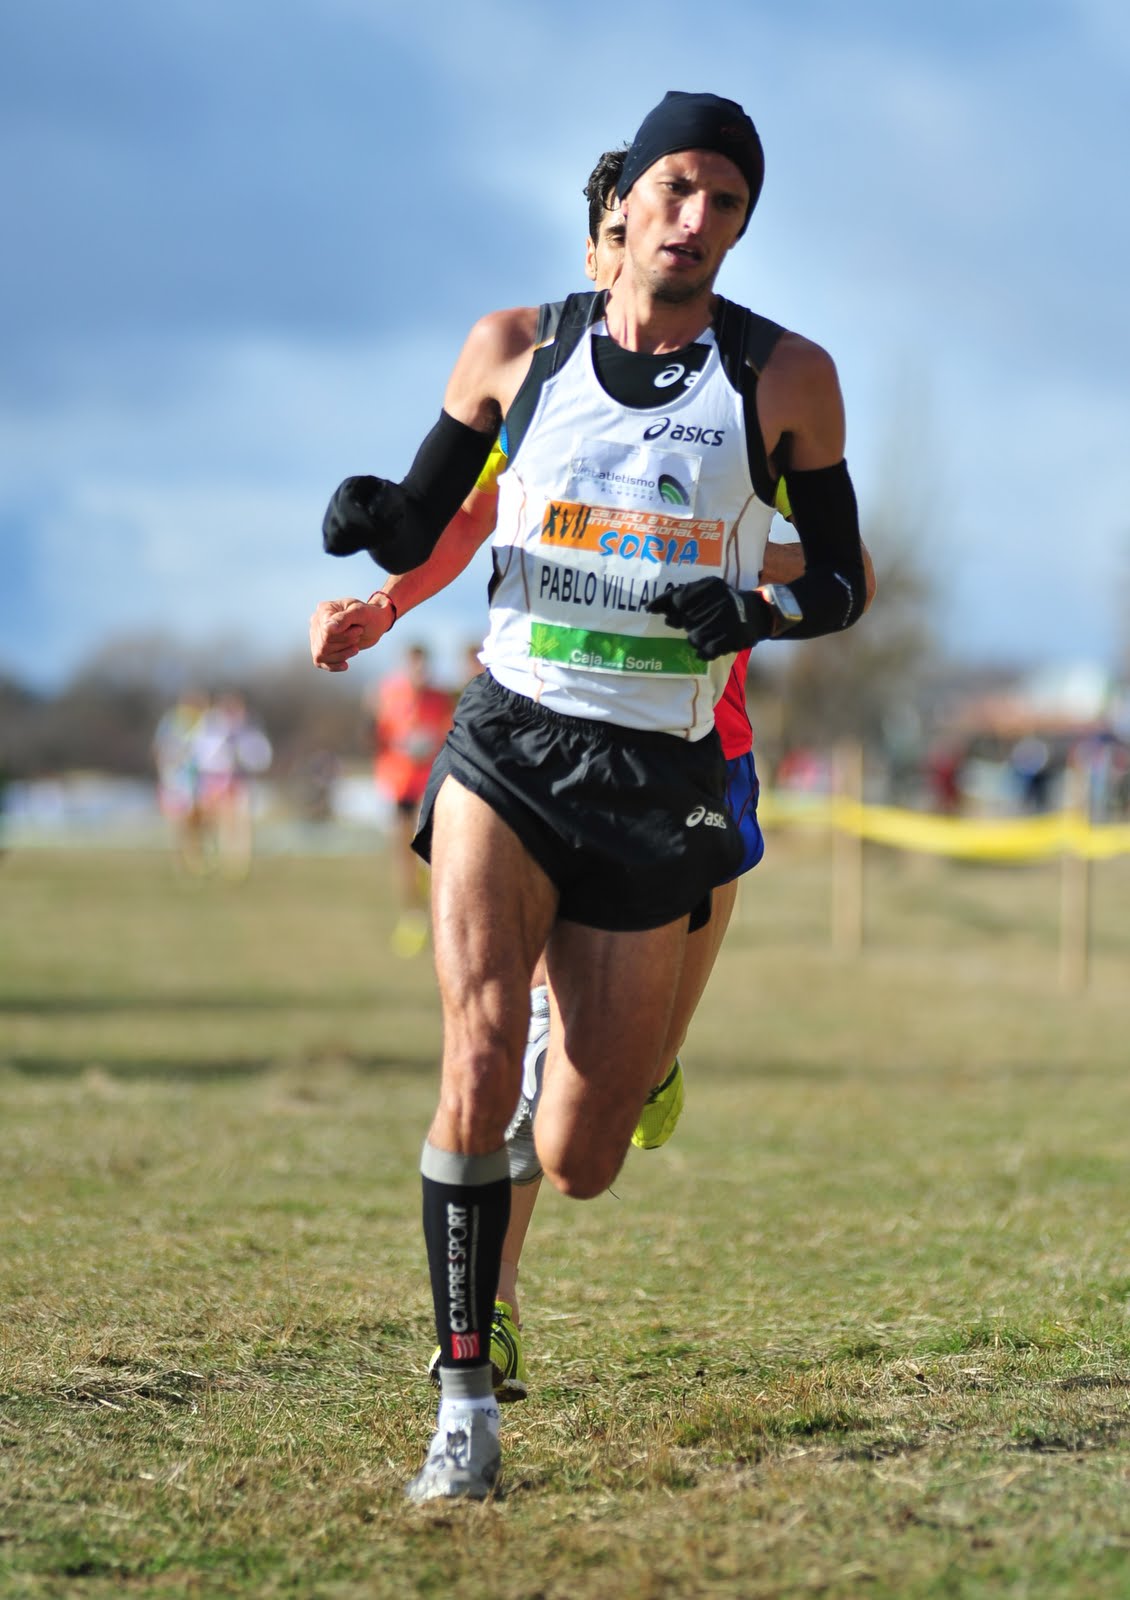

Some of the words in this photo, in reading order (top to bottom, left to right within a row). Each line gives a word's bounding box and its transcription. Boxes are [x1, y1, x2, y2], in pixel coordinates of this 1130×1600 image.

[670, 424, 725, 447] asics
[541, 503, 592, 539] XVII
[599, 530, 699, 567] SORIA
[540, 565, 597, 606] PABLO
[571, 649, 603, 667] Caja
[625, 656, 663, 671] Soria
